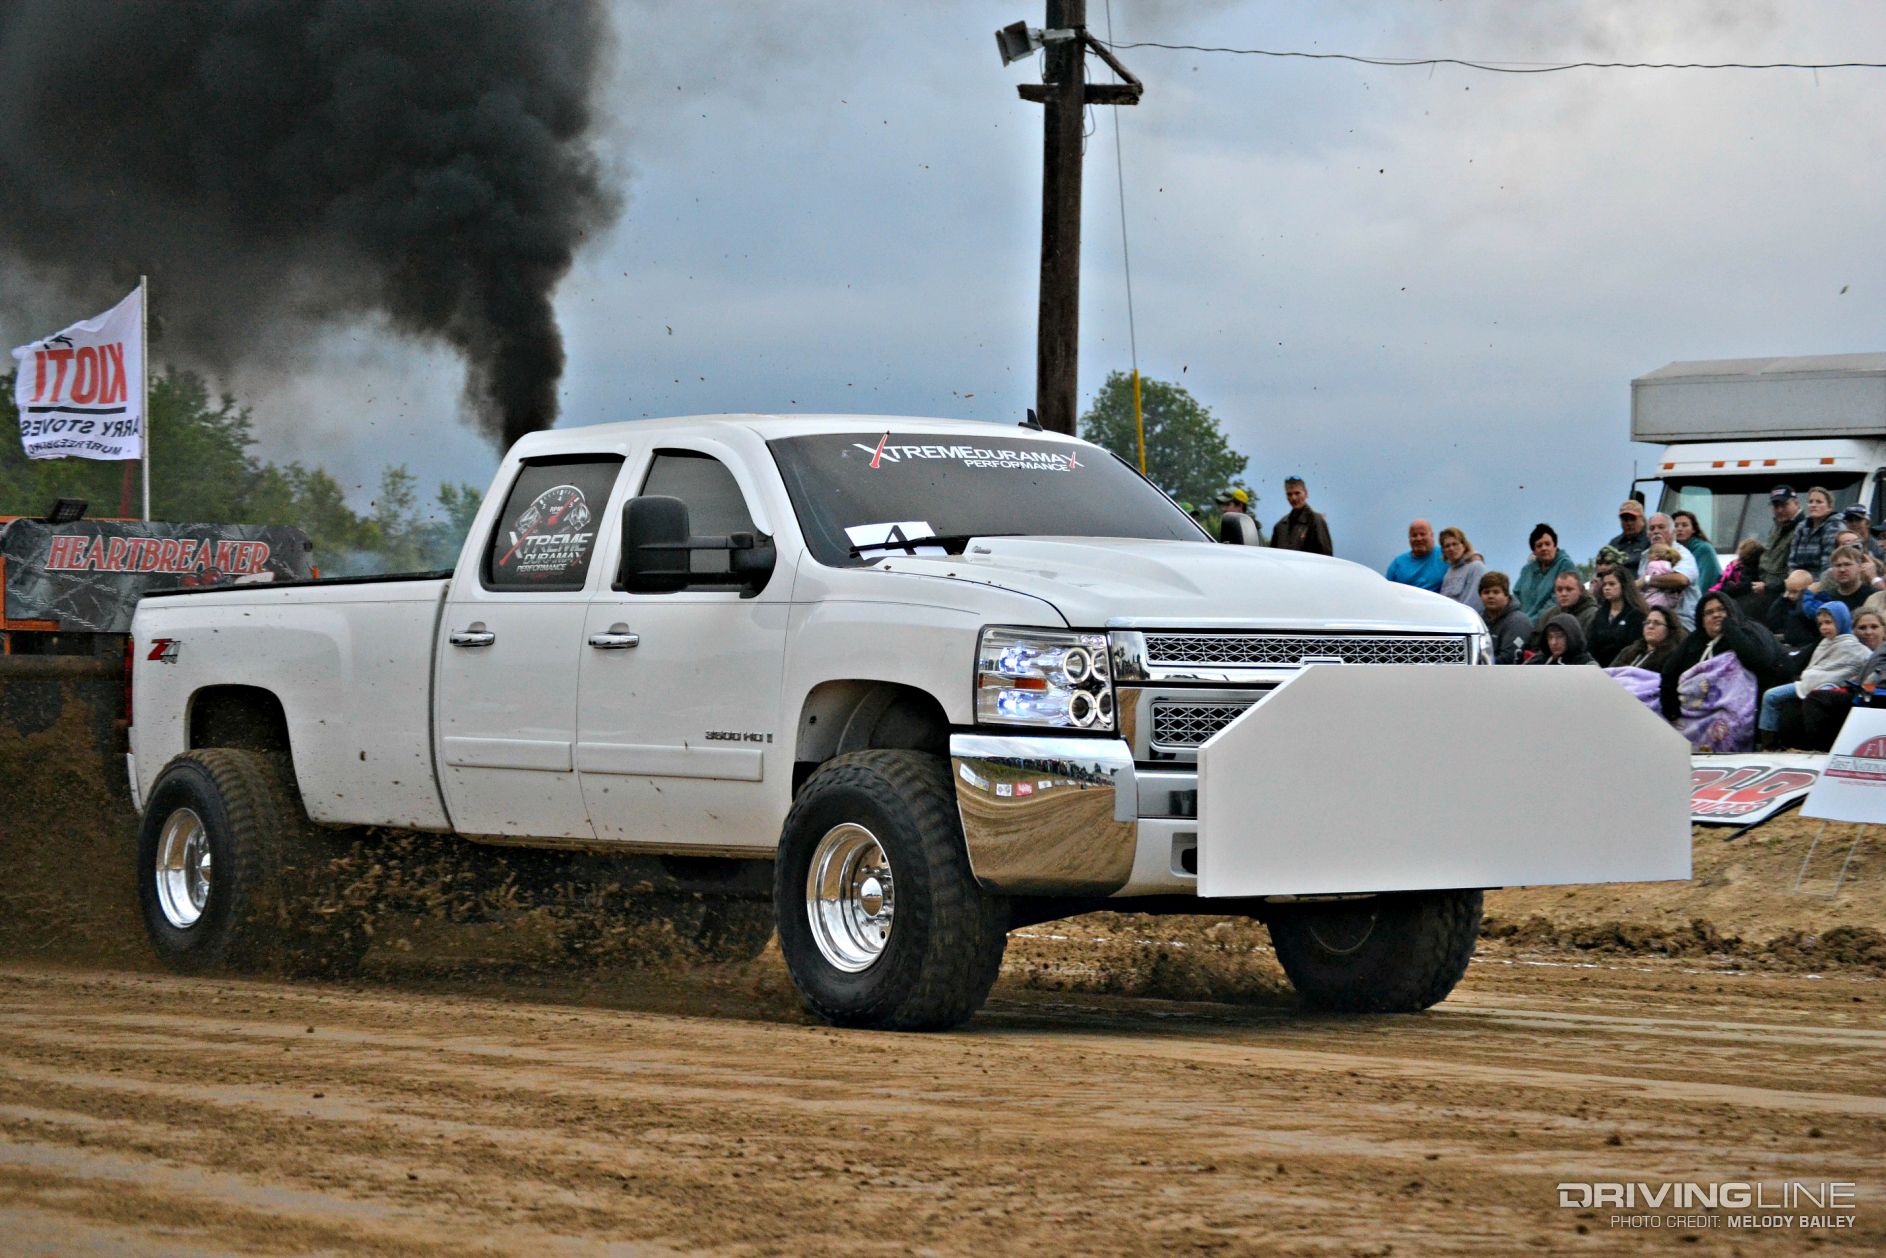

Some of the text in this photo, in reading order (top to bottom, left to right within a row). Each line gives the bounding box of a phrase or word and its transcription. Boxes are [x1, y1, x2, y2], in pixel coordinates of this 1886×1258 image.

[964, 459, 1071, 472] PERFORMANCE
[503, 529, 593, 559] XTREME
[885, 525, 917, 555] A
[45, 535, 270, 574] HEARTBREAKER
[523, 551, 582, 566] DURAMAX
[516, 563, 567, 573] PERFORMANCE
